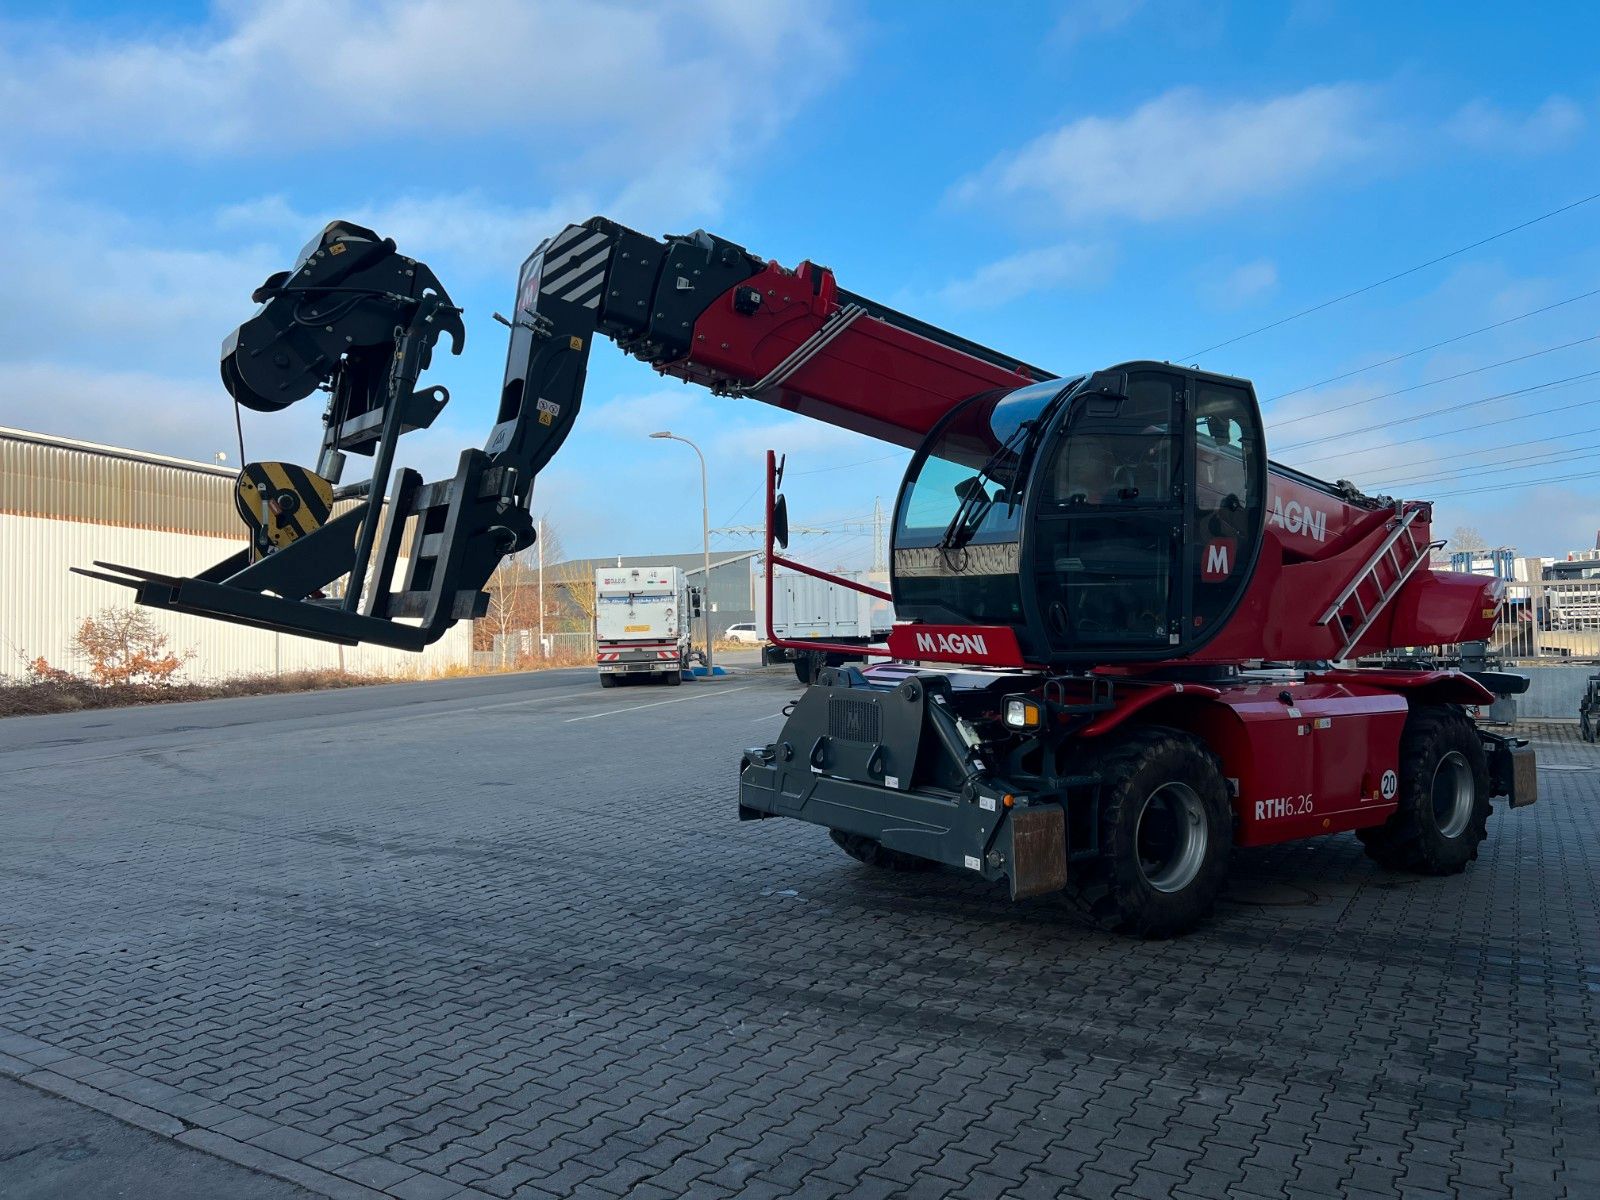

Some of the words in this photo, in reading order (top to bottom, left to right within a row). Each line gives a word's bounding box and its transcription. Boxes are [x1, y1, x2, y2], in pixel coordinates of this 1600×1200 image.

[1268, 496, 1326, 542] AGNI
[1206, 545, 1229, 574] M
[915, 632, 988, 655] MAGNI
[1383, 774, 1395, 794] 20
